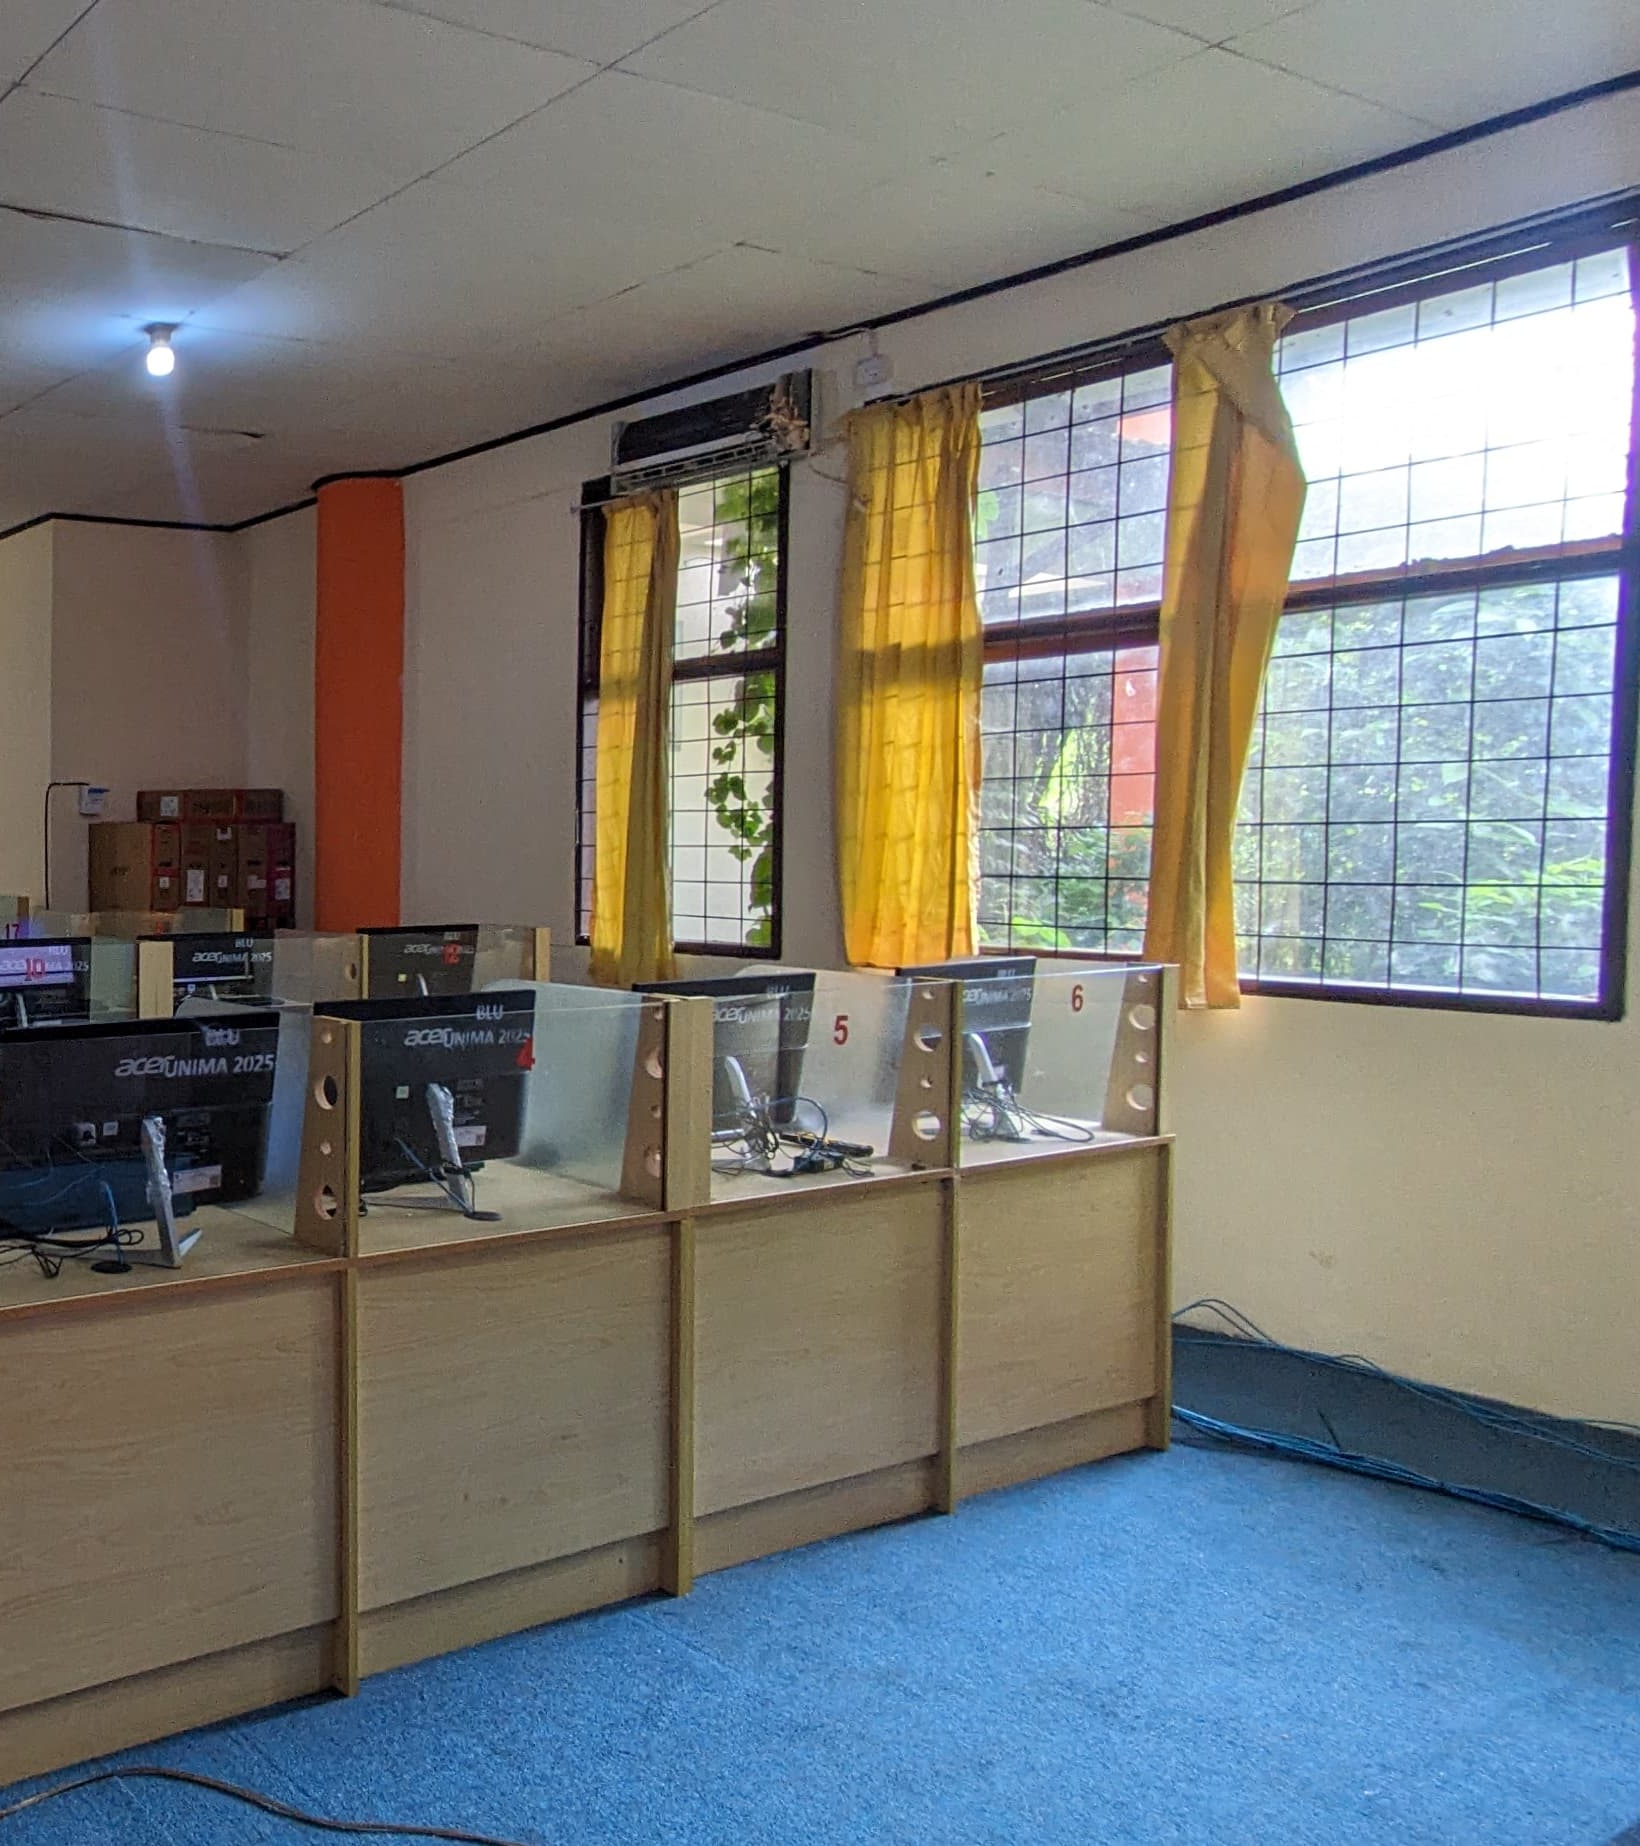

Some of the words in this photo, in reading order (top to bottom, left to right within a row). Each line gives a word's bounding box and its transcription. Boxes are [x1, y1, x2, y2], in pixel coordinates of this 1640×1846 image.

[4, 923, 20, 939] 17
[25, 957, 48, 981] 10
[1071, 984, 1084, 1012] 6
[476, 1004, 505, 1021] BLU
[443, 1029, 494, 1049] UNIMA
[833, 1014, 849, 1046] 5
[164, 1056, 230, 1079] UNIMA
[234, 1053, 275, 1073] 2025
